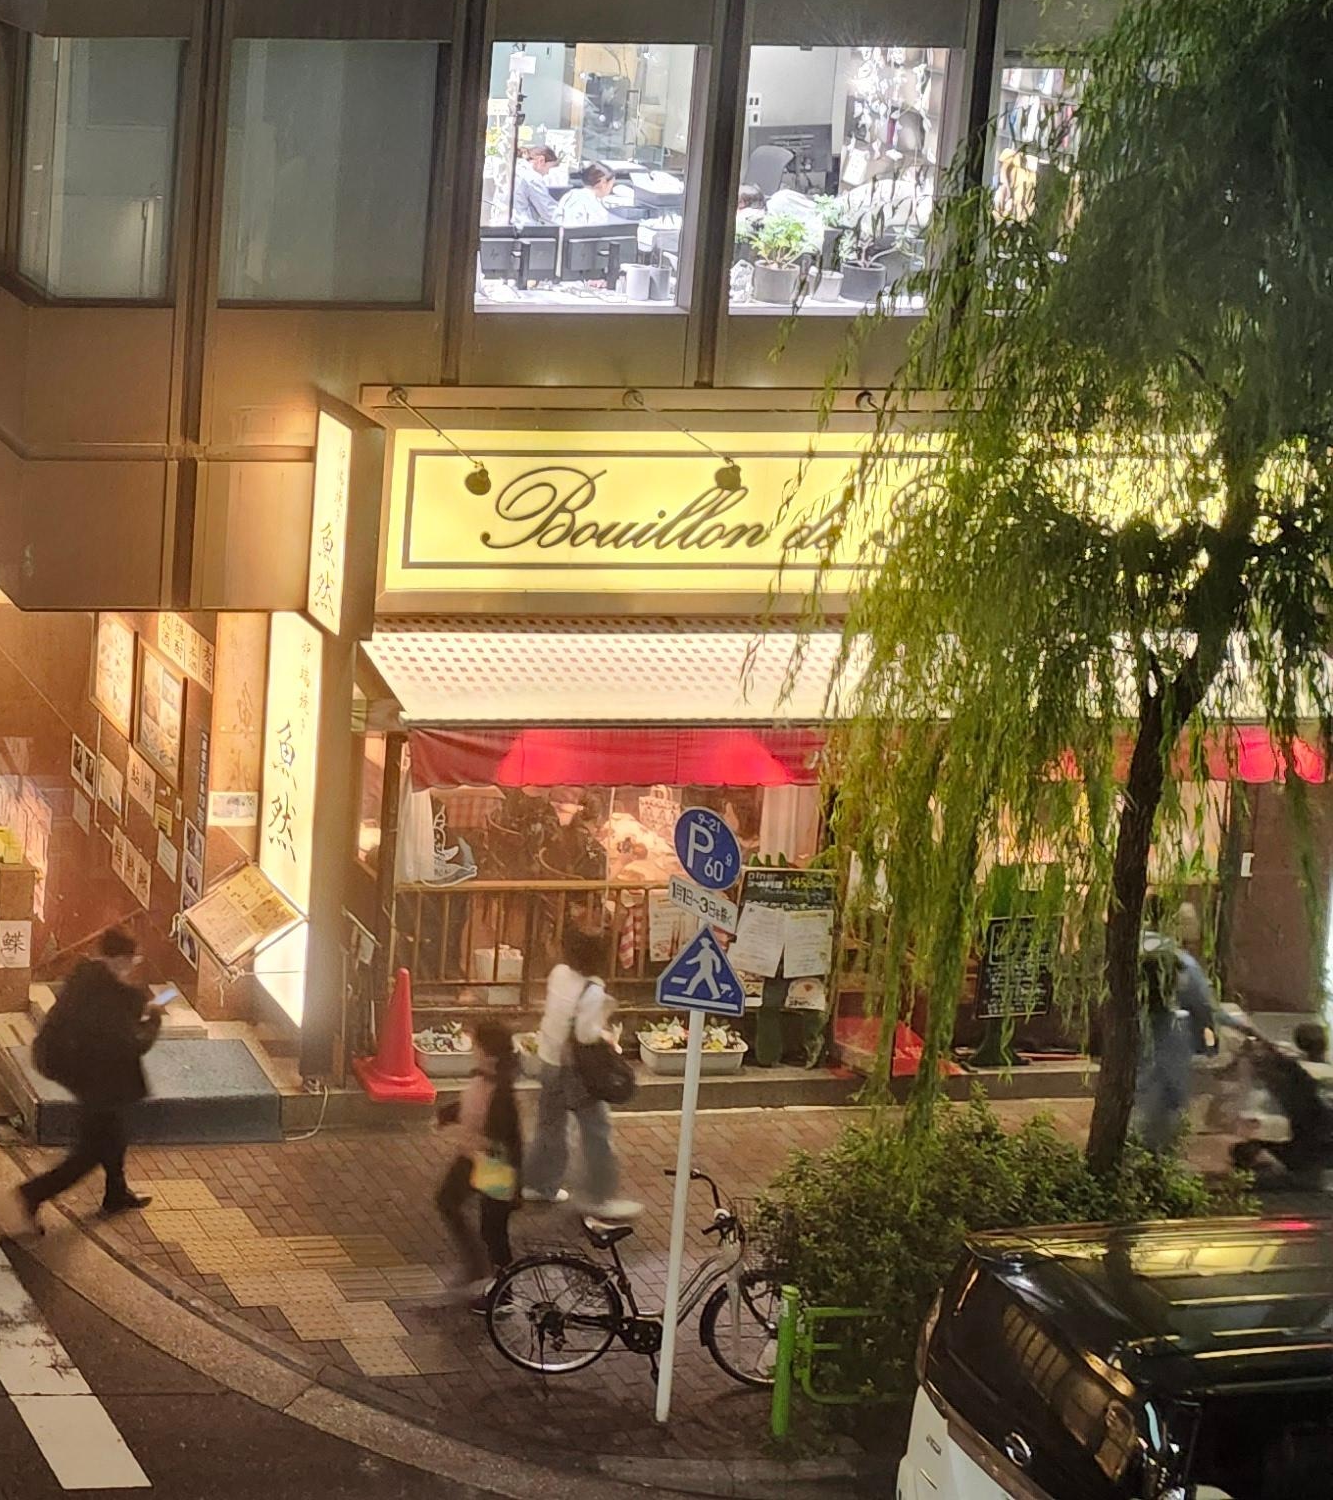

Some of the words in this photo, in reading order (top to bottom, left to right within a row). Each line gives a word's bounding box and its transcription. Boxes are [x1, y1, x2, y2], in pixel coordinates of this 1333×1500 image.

[481, 465, 769, 550] Bouillon
[269, 719, 299, 864] 魚然
[687, 821, 715, 869] P
[698, 813, 721, 833] 9-21
[704, 856, 724, 882] 60
